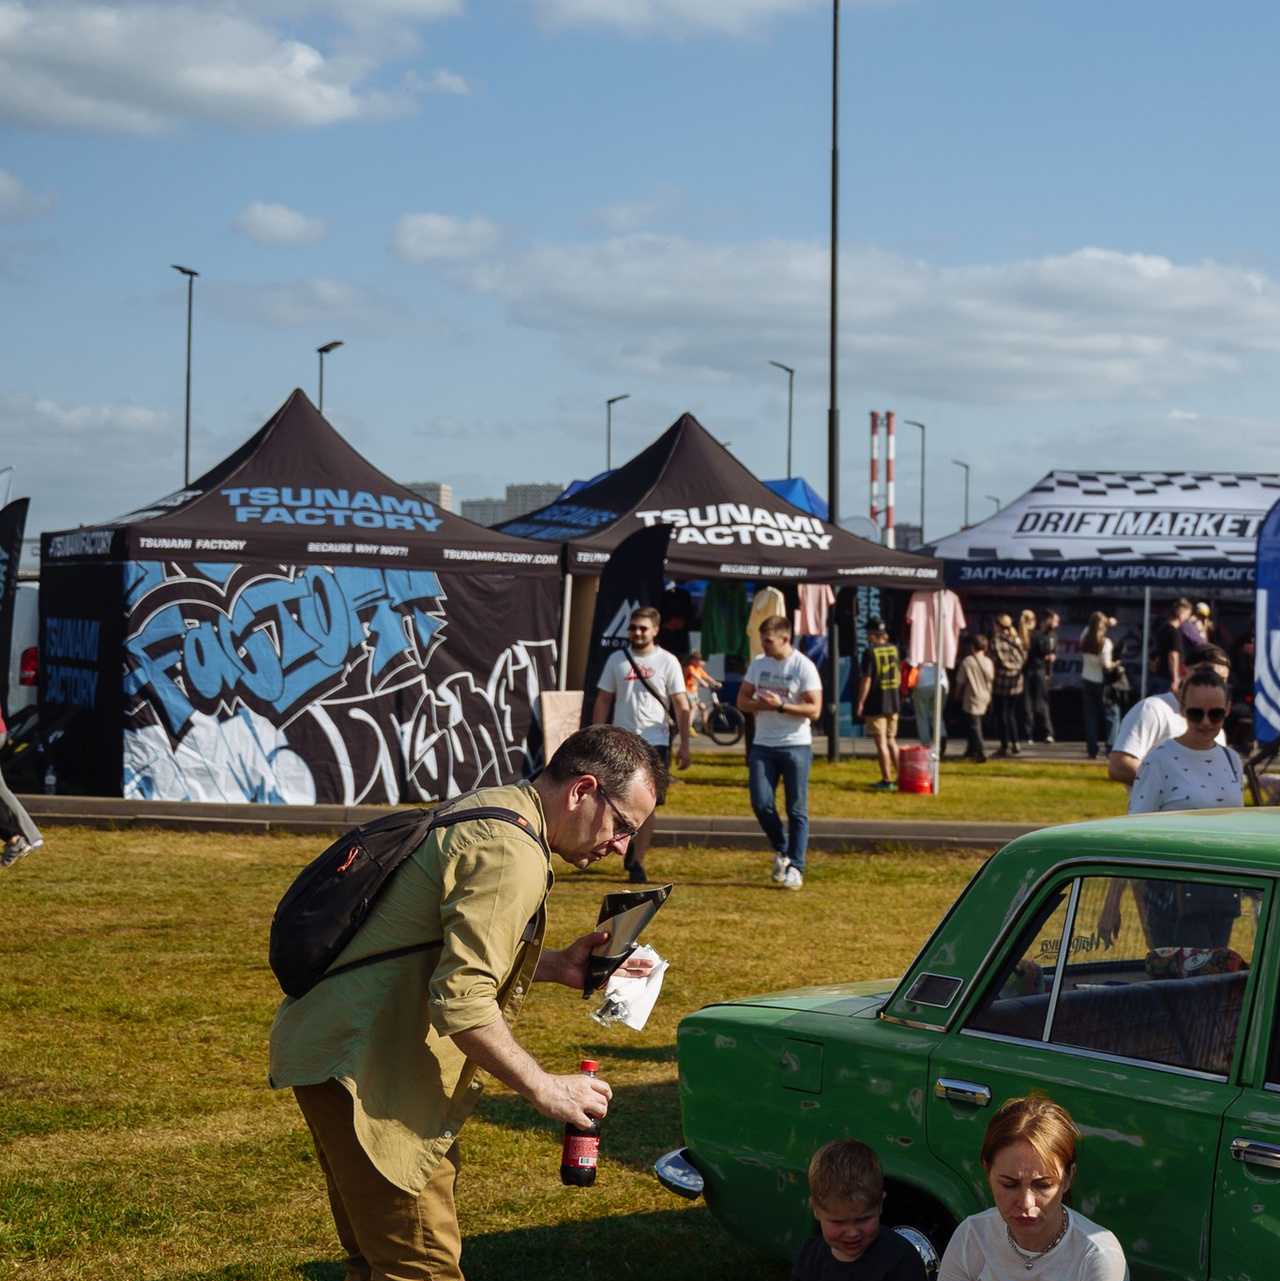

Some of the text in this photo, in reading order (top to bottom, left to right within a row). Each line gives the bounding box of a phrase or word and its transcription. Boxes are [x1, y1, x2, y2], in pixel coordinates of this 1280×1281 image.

[220, 486, 437, 519] TSUNAMI
[235, 506, 444, 532] FACTORY
[635, 502, 825, 535] TSUNAMI
[139, 537, 248, 551] TSUNAMI FACTORY
[670, 524, 833, 551] ACTORY
[307, 542, 353, 553] BECAUSE
[355, 544, 379, 555] WHY
[442, 549, 559, 565] TSUNAMIFACTORY.COM
[960, 565, 1060, 582] ЗАПЧАСТИ
[1062, 565, 1103, 582] ДЛЯ
